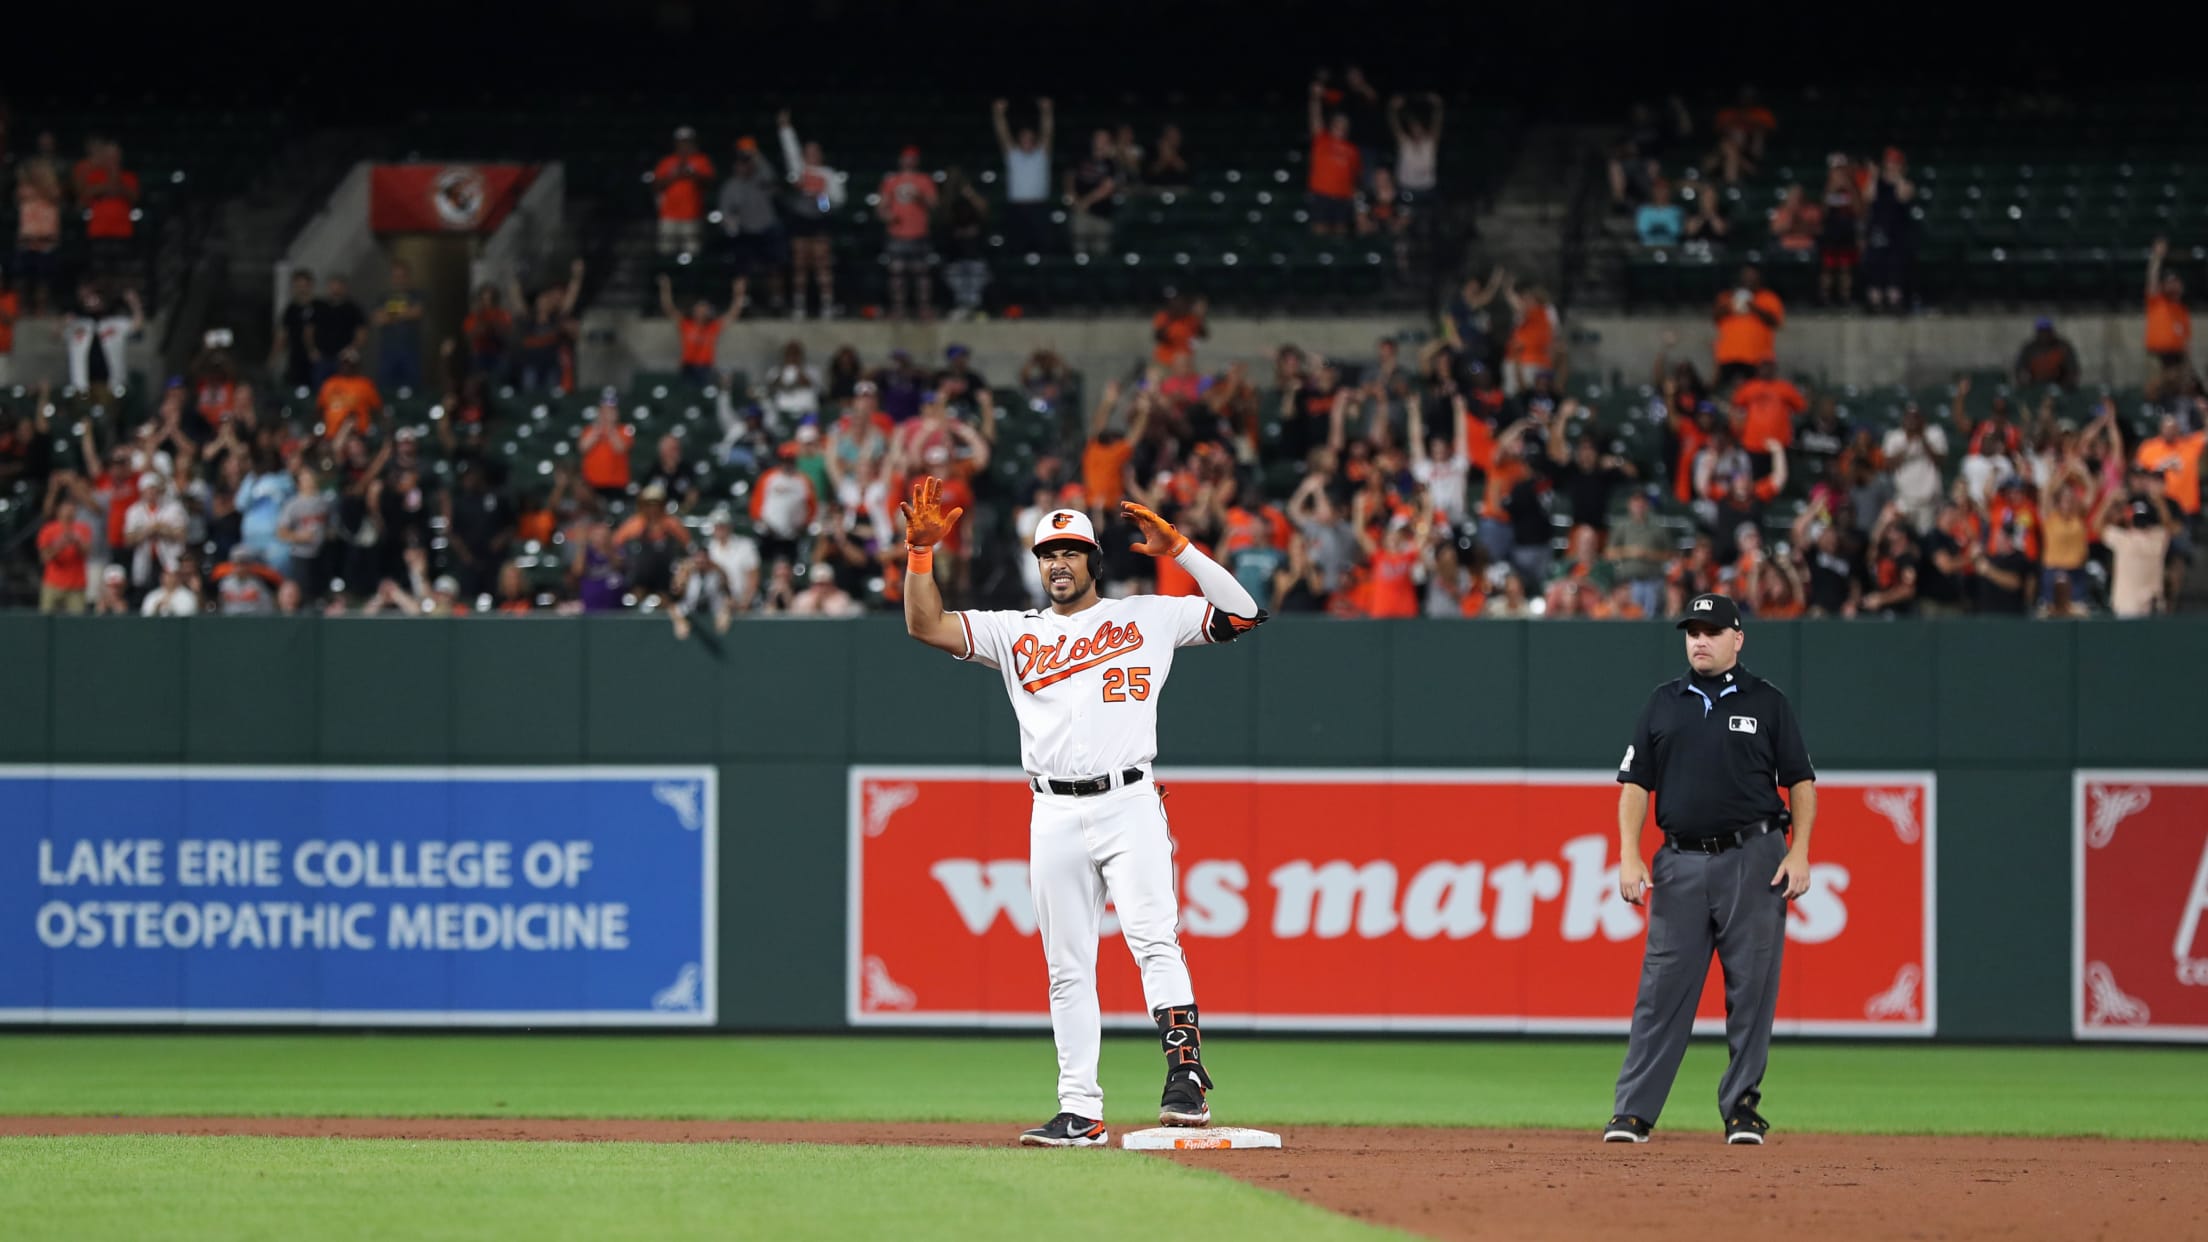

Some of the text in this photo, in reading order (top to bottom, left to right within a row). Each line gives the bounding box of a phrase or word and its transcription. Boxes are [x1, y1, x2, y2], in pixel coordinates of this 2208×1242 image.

[1012, 620, 1144, 682] Orioles
[1102, 666, 1151, 703] 25
[39, 840, 591, 888] LAKE ERIE COLLEGE OF
[931, 834, 1851, 944] ws marks
[37, 902, 629, 951] OSTEOPATHIC MEDICINE
